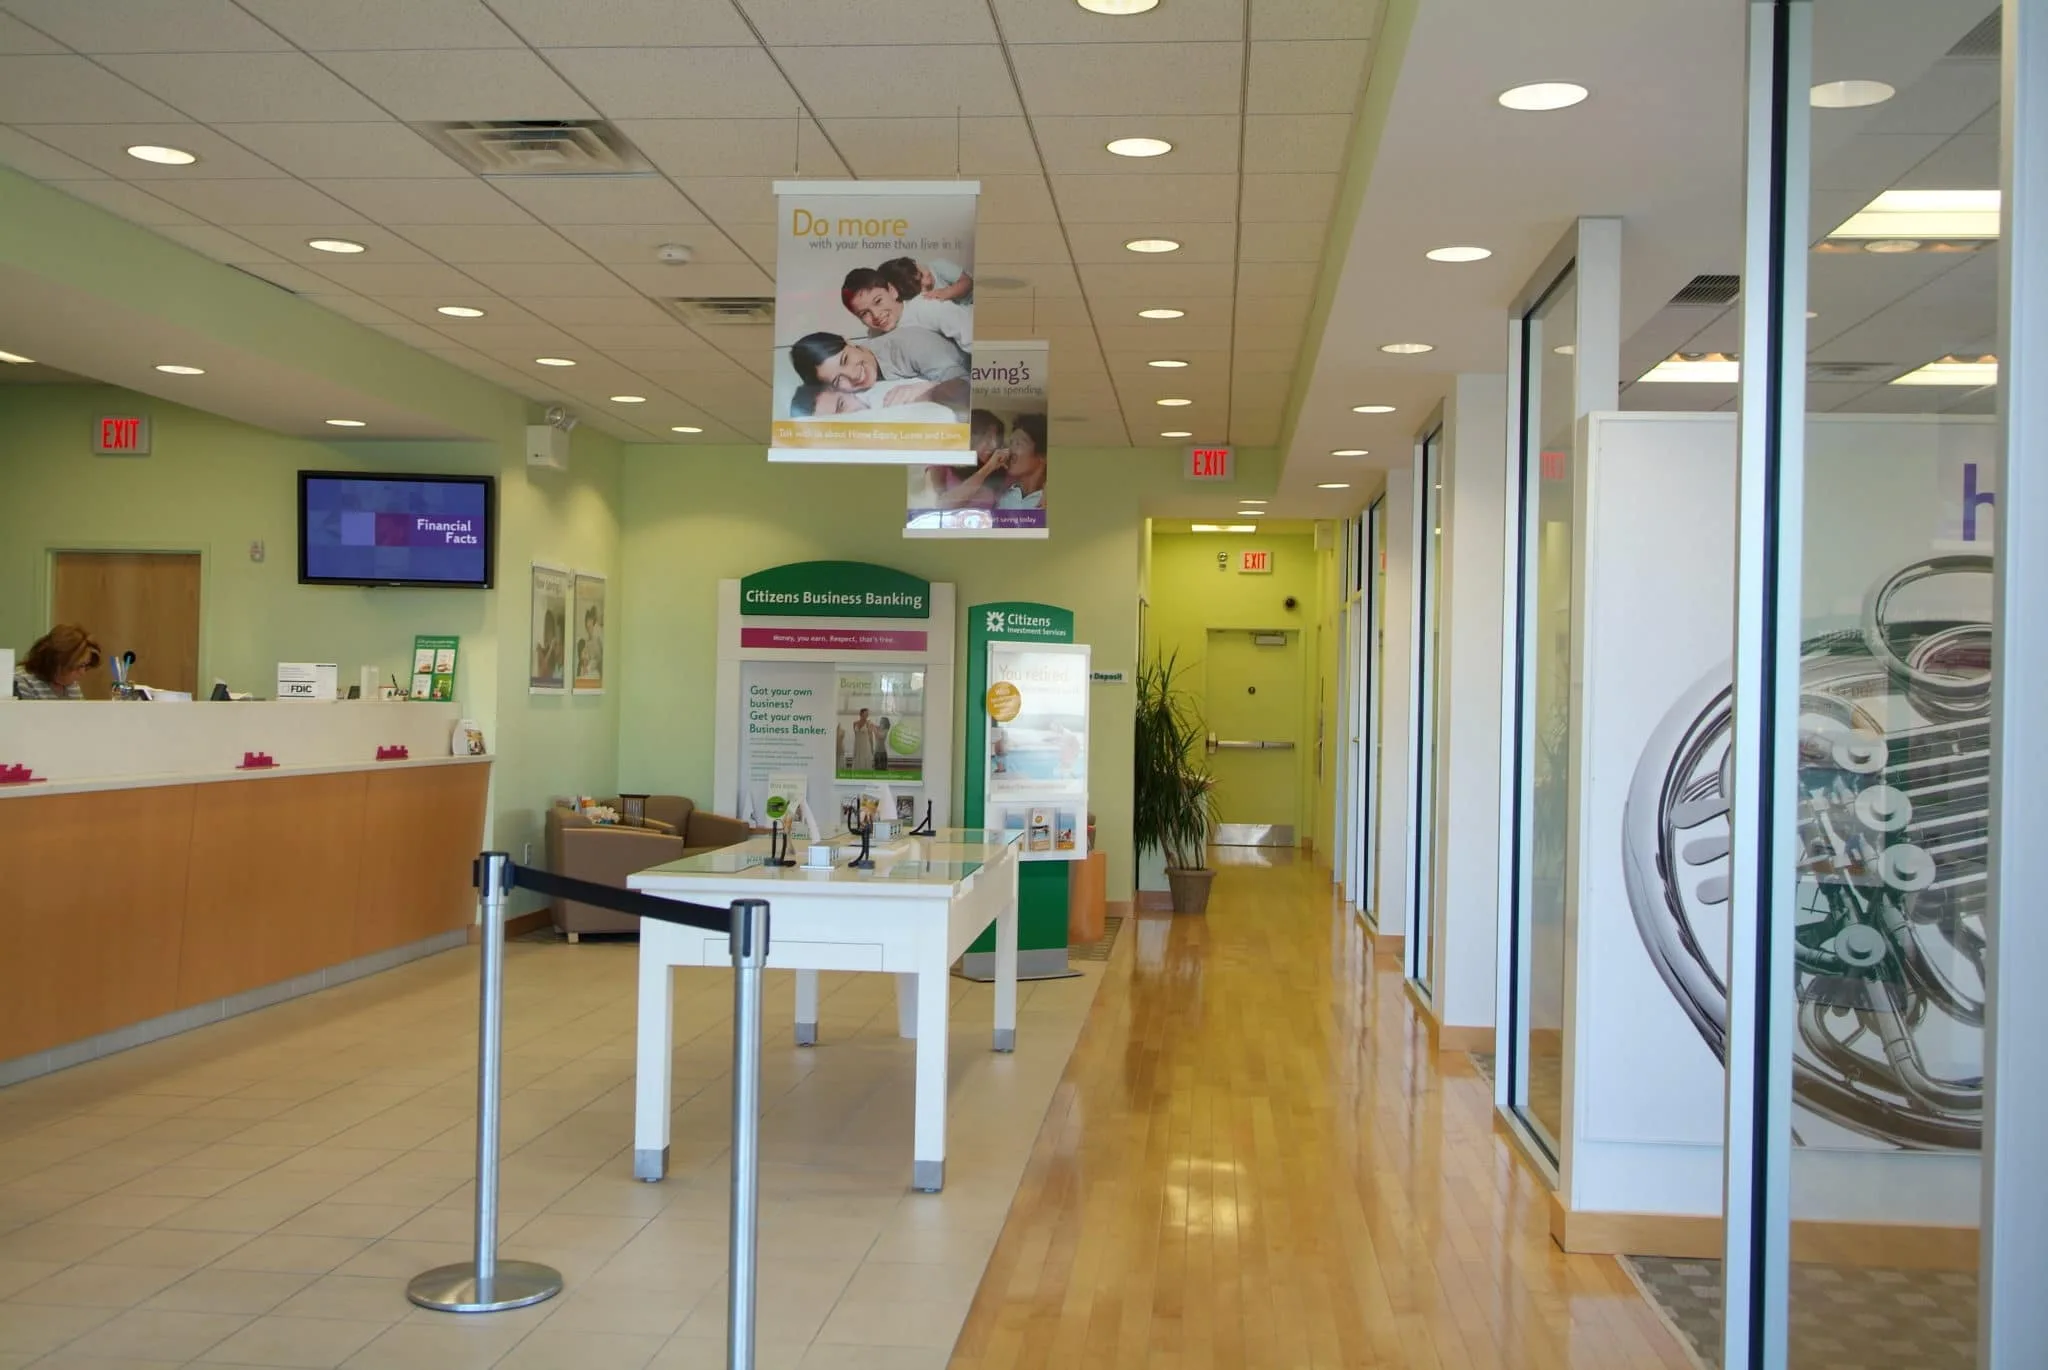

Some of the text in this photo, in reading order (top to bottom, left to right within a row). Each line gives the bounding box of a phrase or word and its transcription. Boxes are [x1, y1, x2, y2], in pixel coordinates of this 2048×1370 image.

[792, 208, 908, 237] Do more
[809, 237, 832, 250] with
[835, 240, 858, 252] your
[862, 238, 892, 250] home
[894, 239, 917, 250] than
[920, 238, 940, 250] live
[942, 239, 951, 250] in
[971, 360, 1030, 385] aving's
[102, 418, 140, 449] EXIT
[1193, 449, 1228, 476] EXIT
[417, 518, 471, 532] Financial
[445, 532, 478, 544] Facts
[1244, 552, 1267, 569] EXIT
[746, 590, 922, 610] Citizens Business Banking
[1007, 613, 1051, 627] Citizens
[1007, 627, 1067, 637] Investment Services
[1094, 672, 1123, 681] Deposit
[290, 684, 312, 693] FDIC
[750, 685, 813, 698] Got your own
[750, 699, 794, 709] business?
[750, 710, 812, 722] Get your own
[749, 723, 827, 735] Business Banker.
